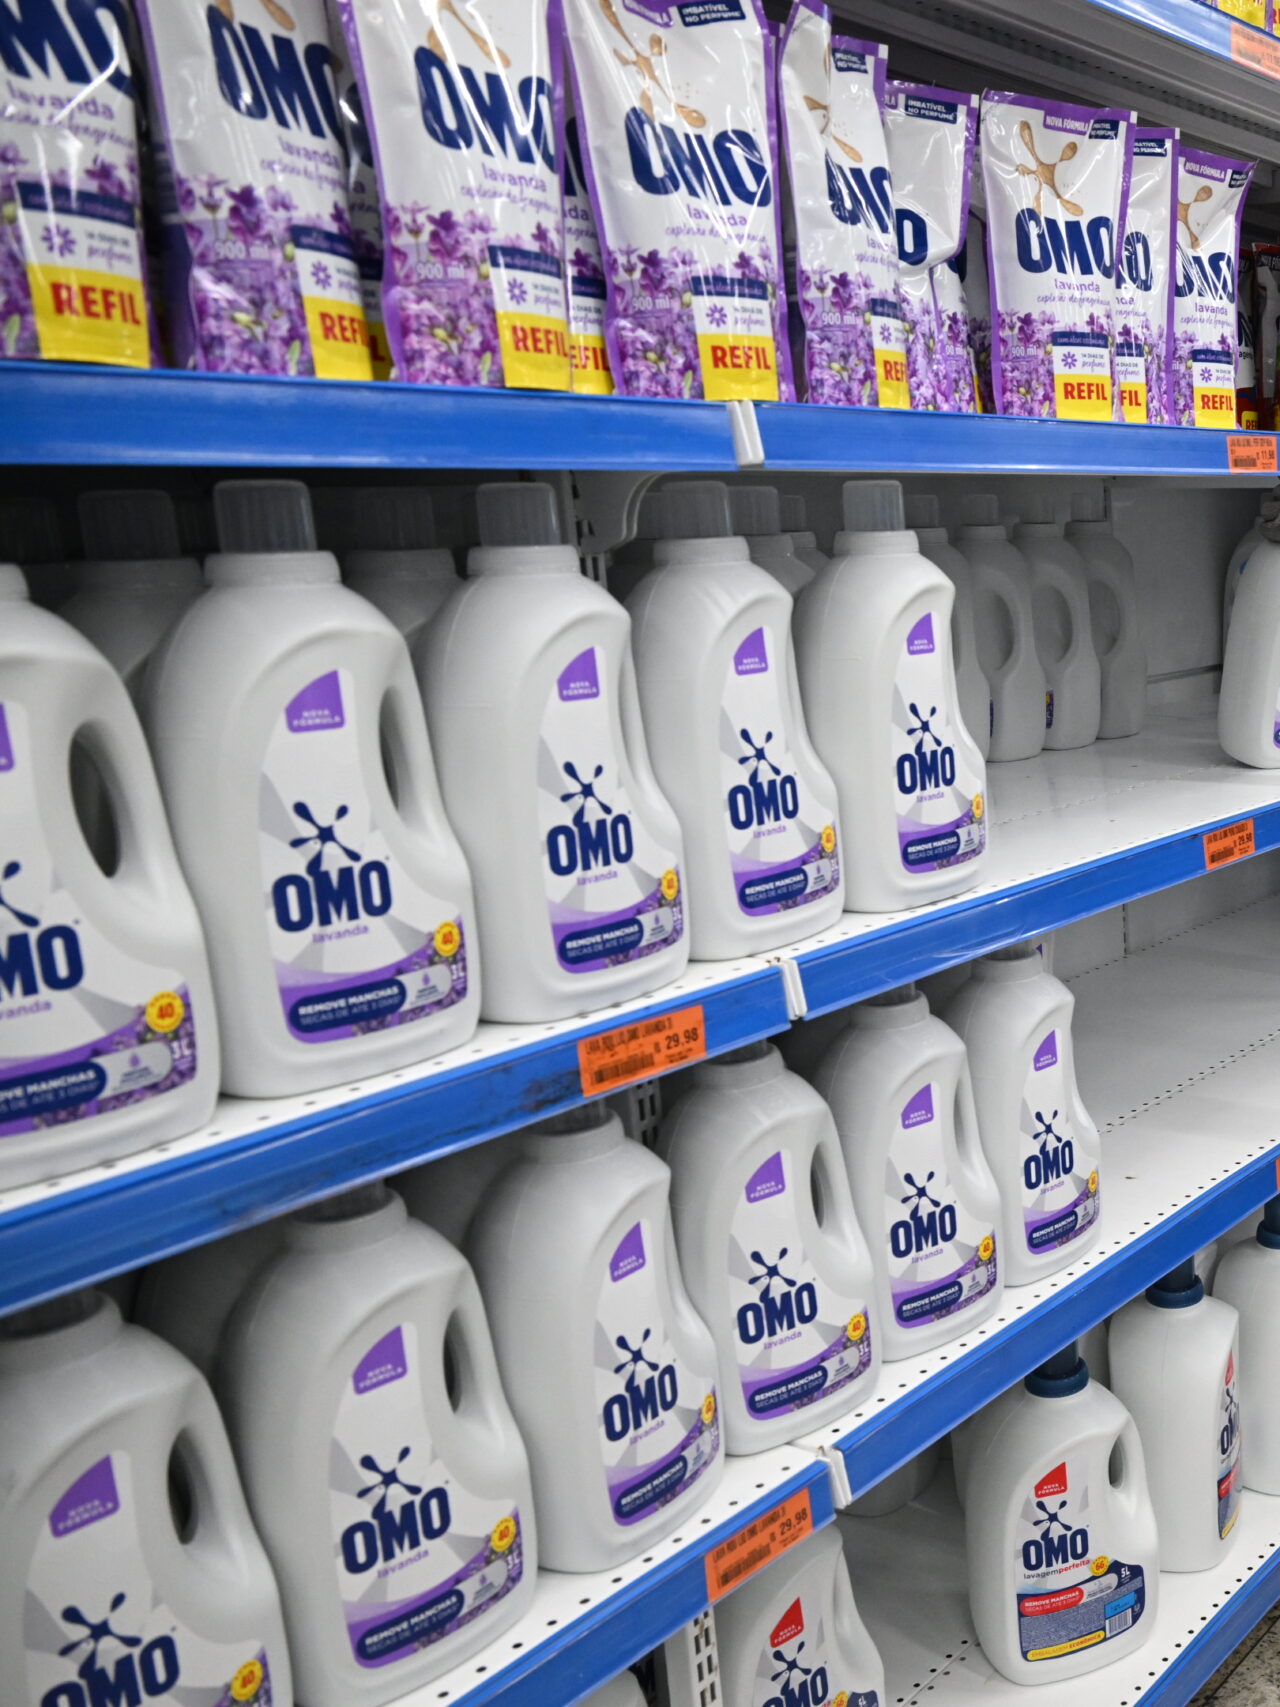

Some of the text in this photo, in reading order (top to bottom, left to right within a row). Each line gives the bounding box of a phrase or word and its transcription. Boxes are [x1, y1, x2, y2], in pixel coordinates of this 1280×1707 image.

[685, 10, 741, 23] NO PERFUME
[908, 100, 946, 113] IMBATÍVEL
[1046, 115, 1064, 128] NOVA
[279, 136, 341, 170] lavanda
[625, 106, 772, 208] OMO
[482, 163, 548, 193] lavanda
[215, 241, 246, 258] 900
[1015, 207, 1114, 280] OMO
[417, 263, 465, 279] 900 ml
[1055, 279, 1100, 293] lavanda
[51, 282, 141, 326] REFIL
[632, 297, 653, 310] 900
[1195, 303, 1228, 316] lavanda
[822, 313, 841, 325] 900
[512, 326, 569, 357] REFIL
[712, 344, 772, 371] REFIL
[1064, 382, 1108, 401] REFIL
[1201, 393, 1234, 412] REFIL
[896, 746, 956, 795] OMO
[728, 775, 799, 830] OMO
[916, 791, 945, 803] lavanda
[546, 813, 634, 877] OMO
[753, 825, 787, 839] lavanda
[577, 870, 618, 886] lavanda
[271, 860, 393, 933] OMO
[312, 924, 369, 944] lavanda
[566, 934, 602, 949] REMOVE
[0, 924, 84, 1000] MO
[298, 985, 400, 1015] REMOVE MANCHAS
[665, 1027, 699, 1050] 29.98
[27, 1069, 97, 1100] MANCHAS
[1024, 1139, 1074, 1190] OMO
[890, 1204, 957, 1259] OMO
[911, 1247, 944, 1264] lavanda
[902, 1285, 959, 1311] REMOVE MANCHAS
[737, 1282, 818, 1345] OMO
[764, 1330, 802, 1350] lavanda
[755, 1370, 823, 1401] REMOVE MANCHAS
[602, 1364, 678, 1442] OMO
[630, 1419, 665, 1446] lavanda
[341, 1486, 451, 1575] OMO
[779, 1507, 808, 1536] 29.98
[378, 1549, 430, 1579] lavanda
[1022, 1528, 1089, 1571] OMO
[365, 1595, 457, 1646] REMOVE MANCHAS
